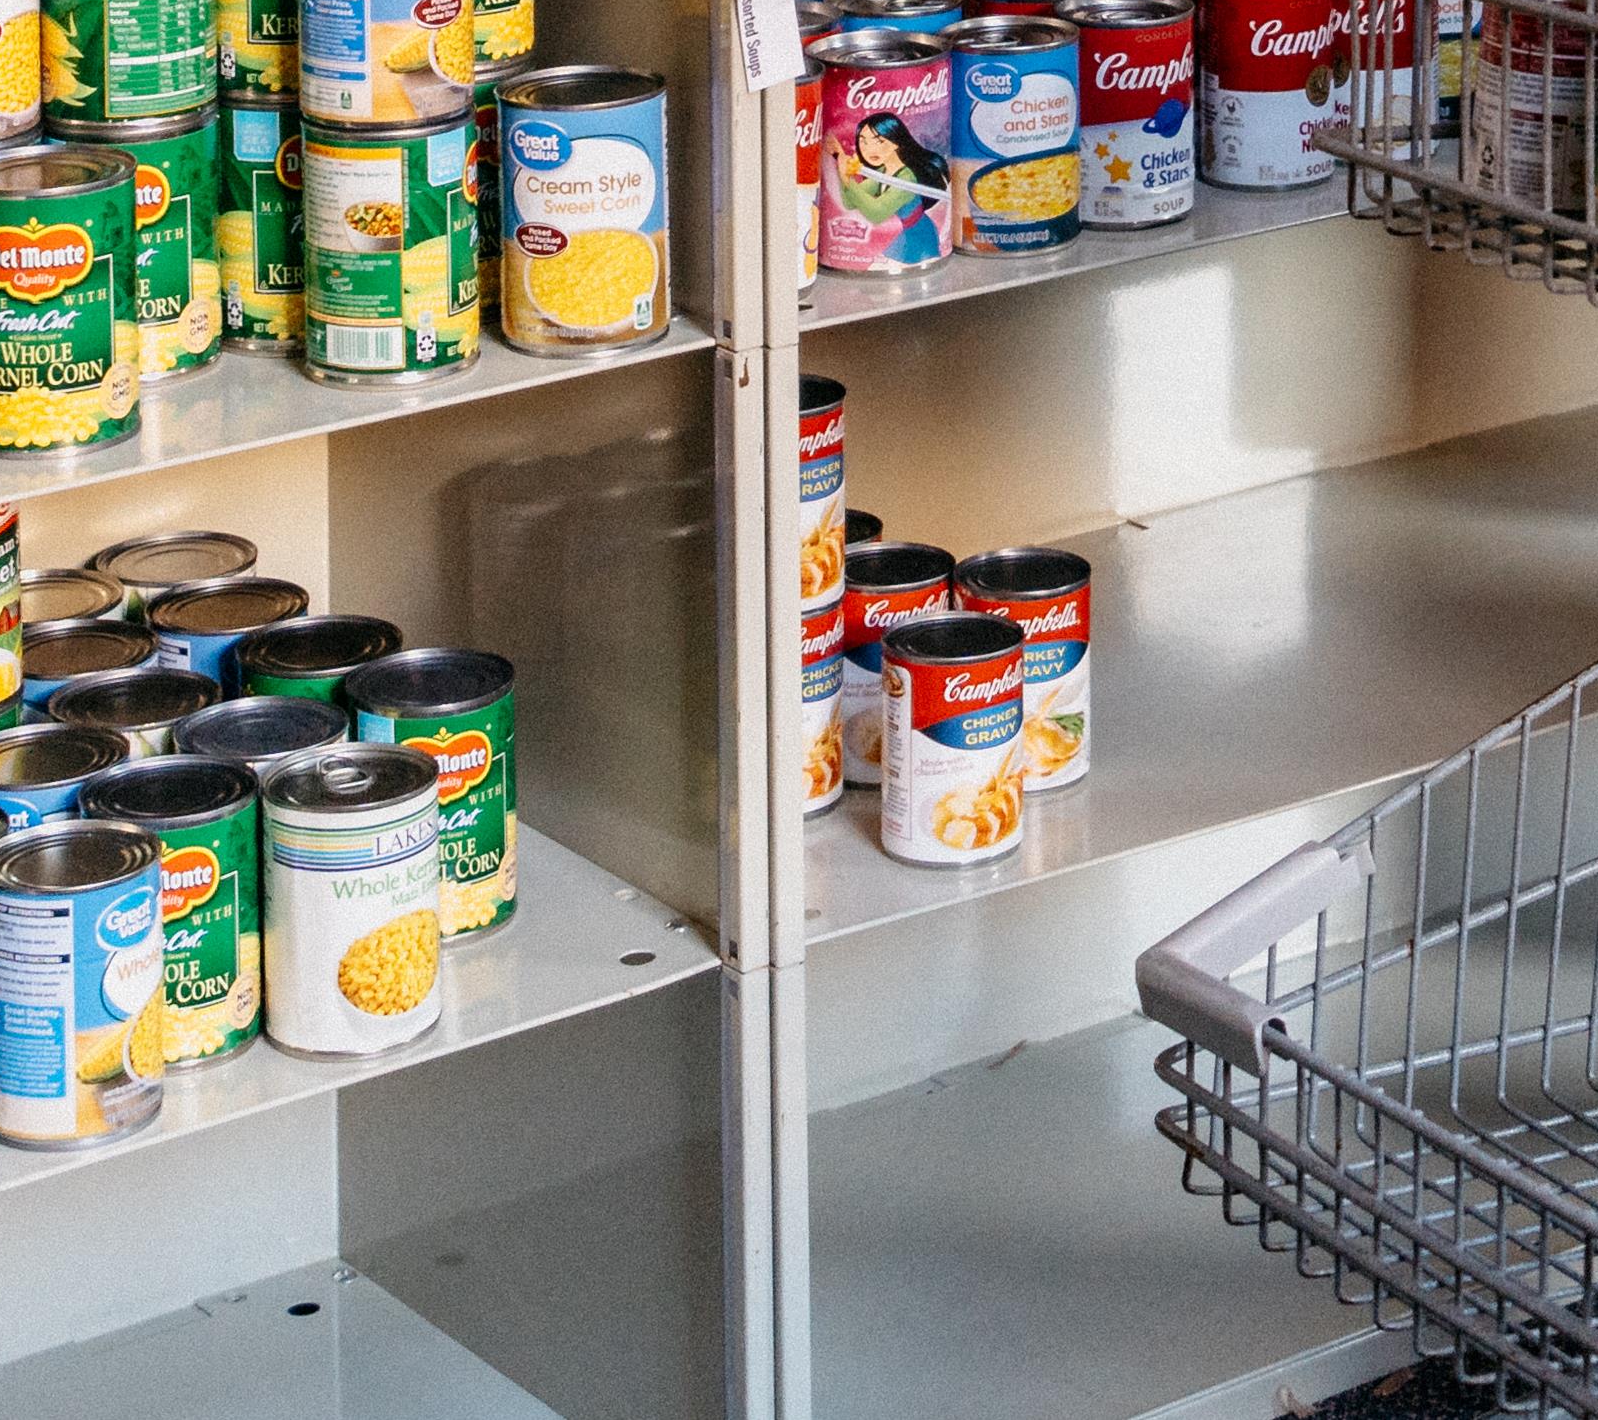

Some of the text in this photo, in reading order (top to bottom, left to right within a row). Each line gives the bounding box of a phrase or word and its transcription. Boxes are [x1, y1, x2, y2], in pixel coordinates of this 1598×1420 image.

[1011, 96, 1069, 114] Chicken
[1004, 113, 1069, 131] and Stars
[512, 132, 560, 153] Great
[524, 146, 559, 161] Value
[1141, 148, 1190, 170] Chicken
[526, 169, 642, 196] Cream Style
[1143, 167, 1189, 186] & Stars
[544, 195, 641, 216] Sweet Corn
[1154, 199, 1185, 214] SOUP
[962, 707, 1017, 732] CHICKEN
[965, 723, 1017, 746] GRAVY
